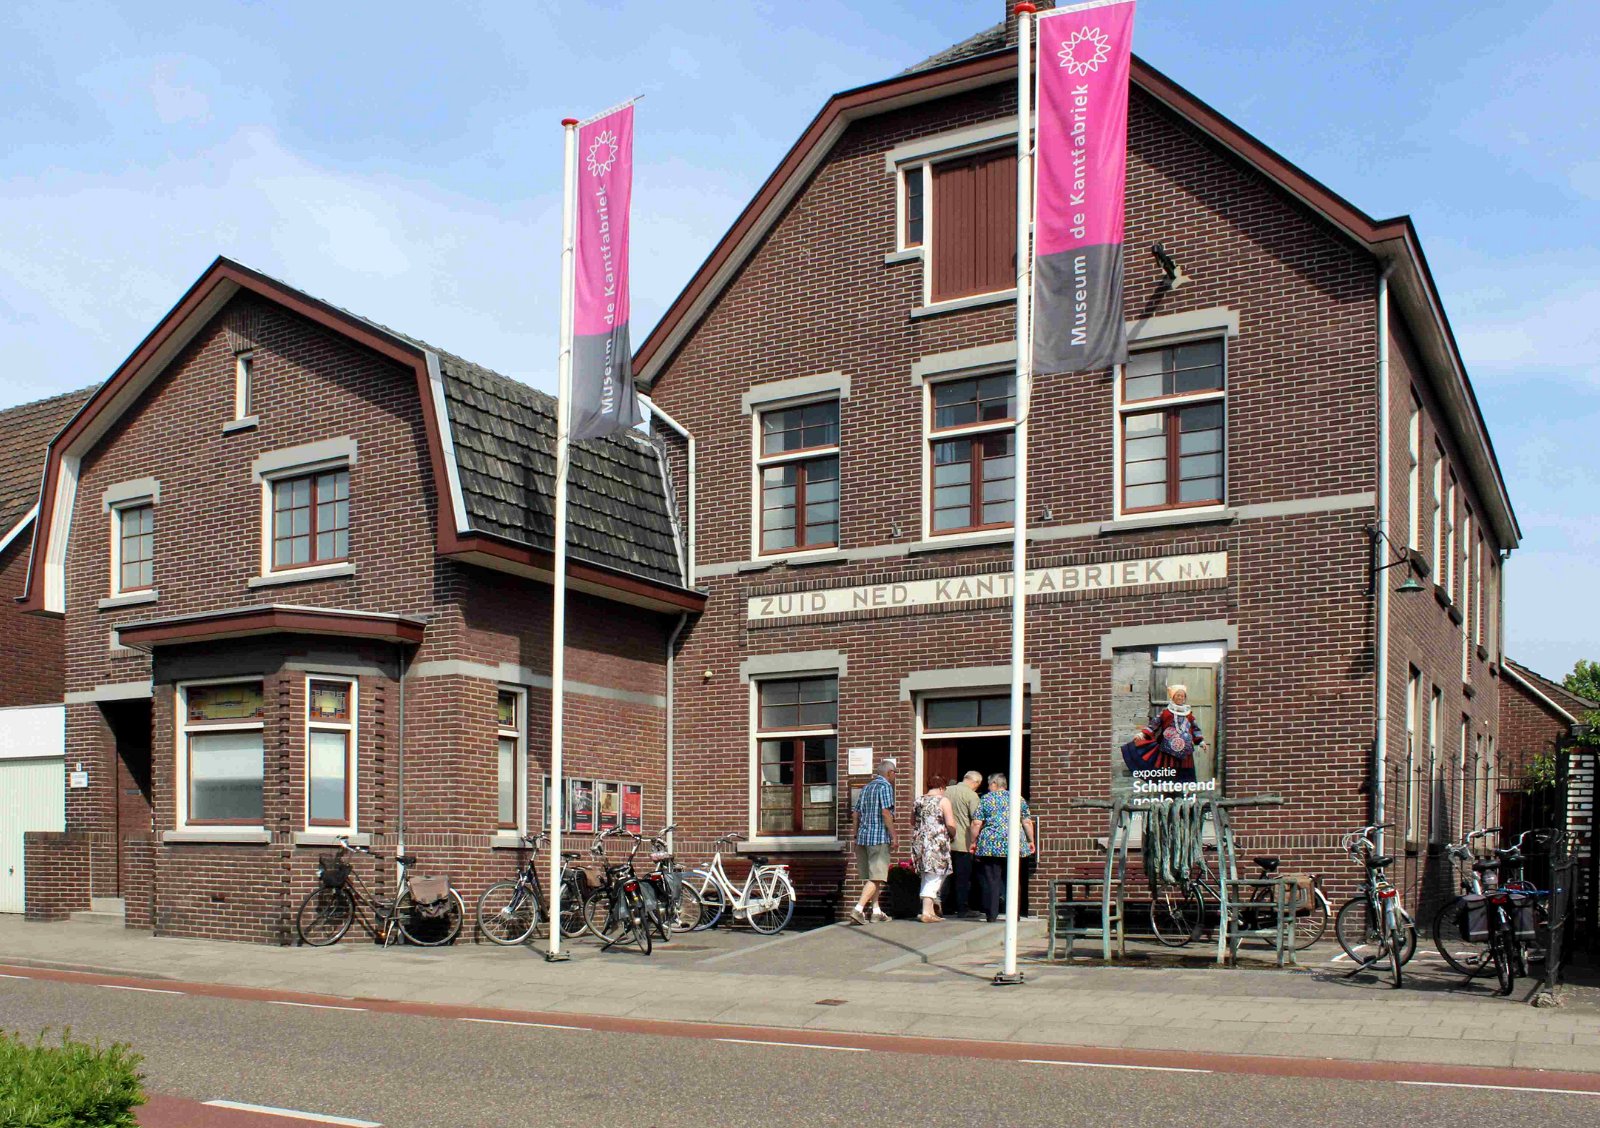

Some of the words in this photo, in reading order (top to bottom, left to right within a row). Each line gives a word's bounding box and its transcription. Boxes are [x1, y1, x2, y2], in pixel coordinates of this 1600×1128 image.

[1070, 84, 1089, 206] Kantfabriek
[597, 184, 615, 297] Kantfabriek
[1070, 213, 1086, 239] de
[604, 303, 614, 325] de
[1071, 255, 1087, 347] Museum
[602, 338, 614, 415] Museum
[761, 593, 827, 615] ZUID
[853, 584, 915, 608] NED.
[1179, 561, 1213, 579] N.V.
[1132, 767, 1176, 779] expositie
[1133, 778, 1215, 792] Schitterend
